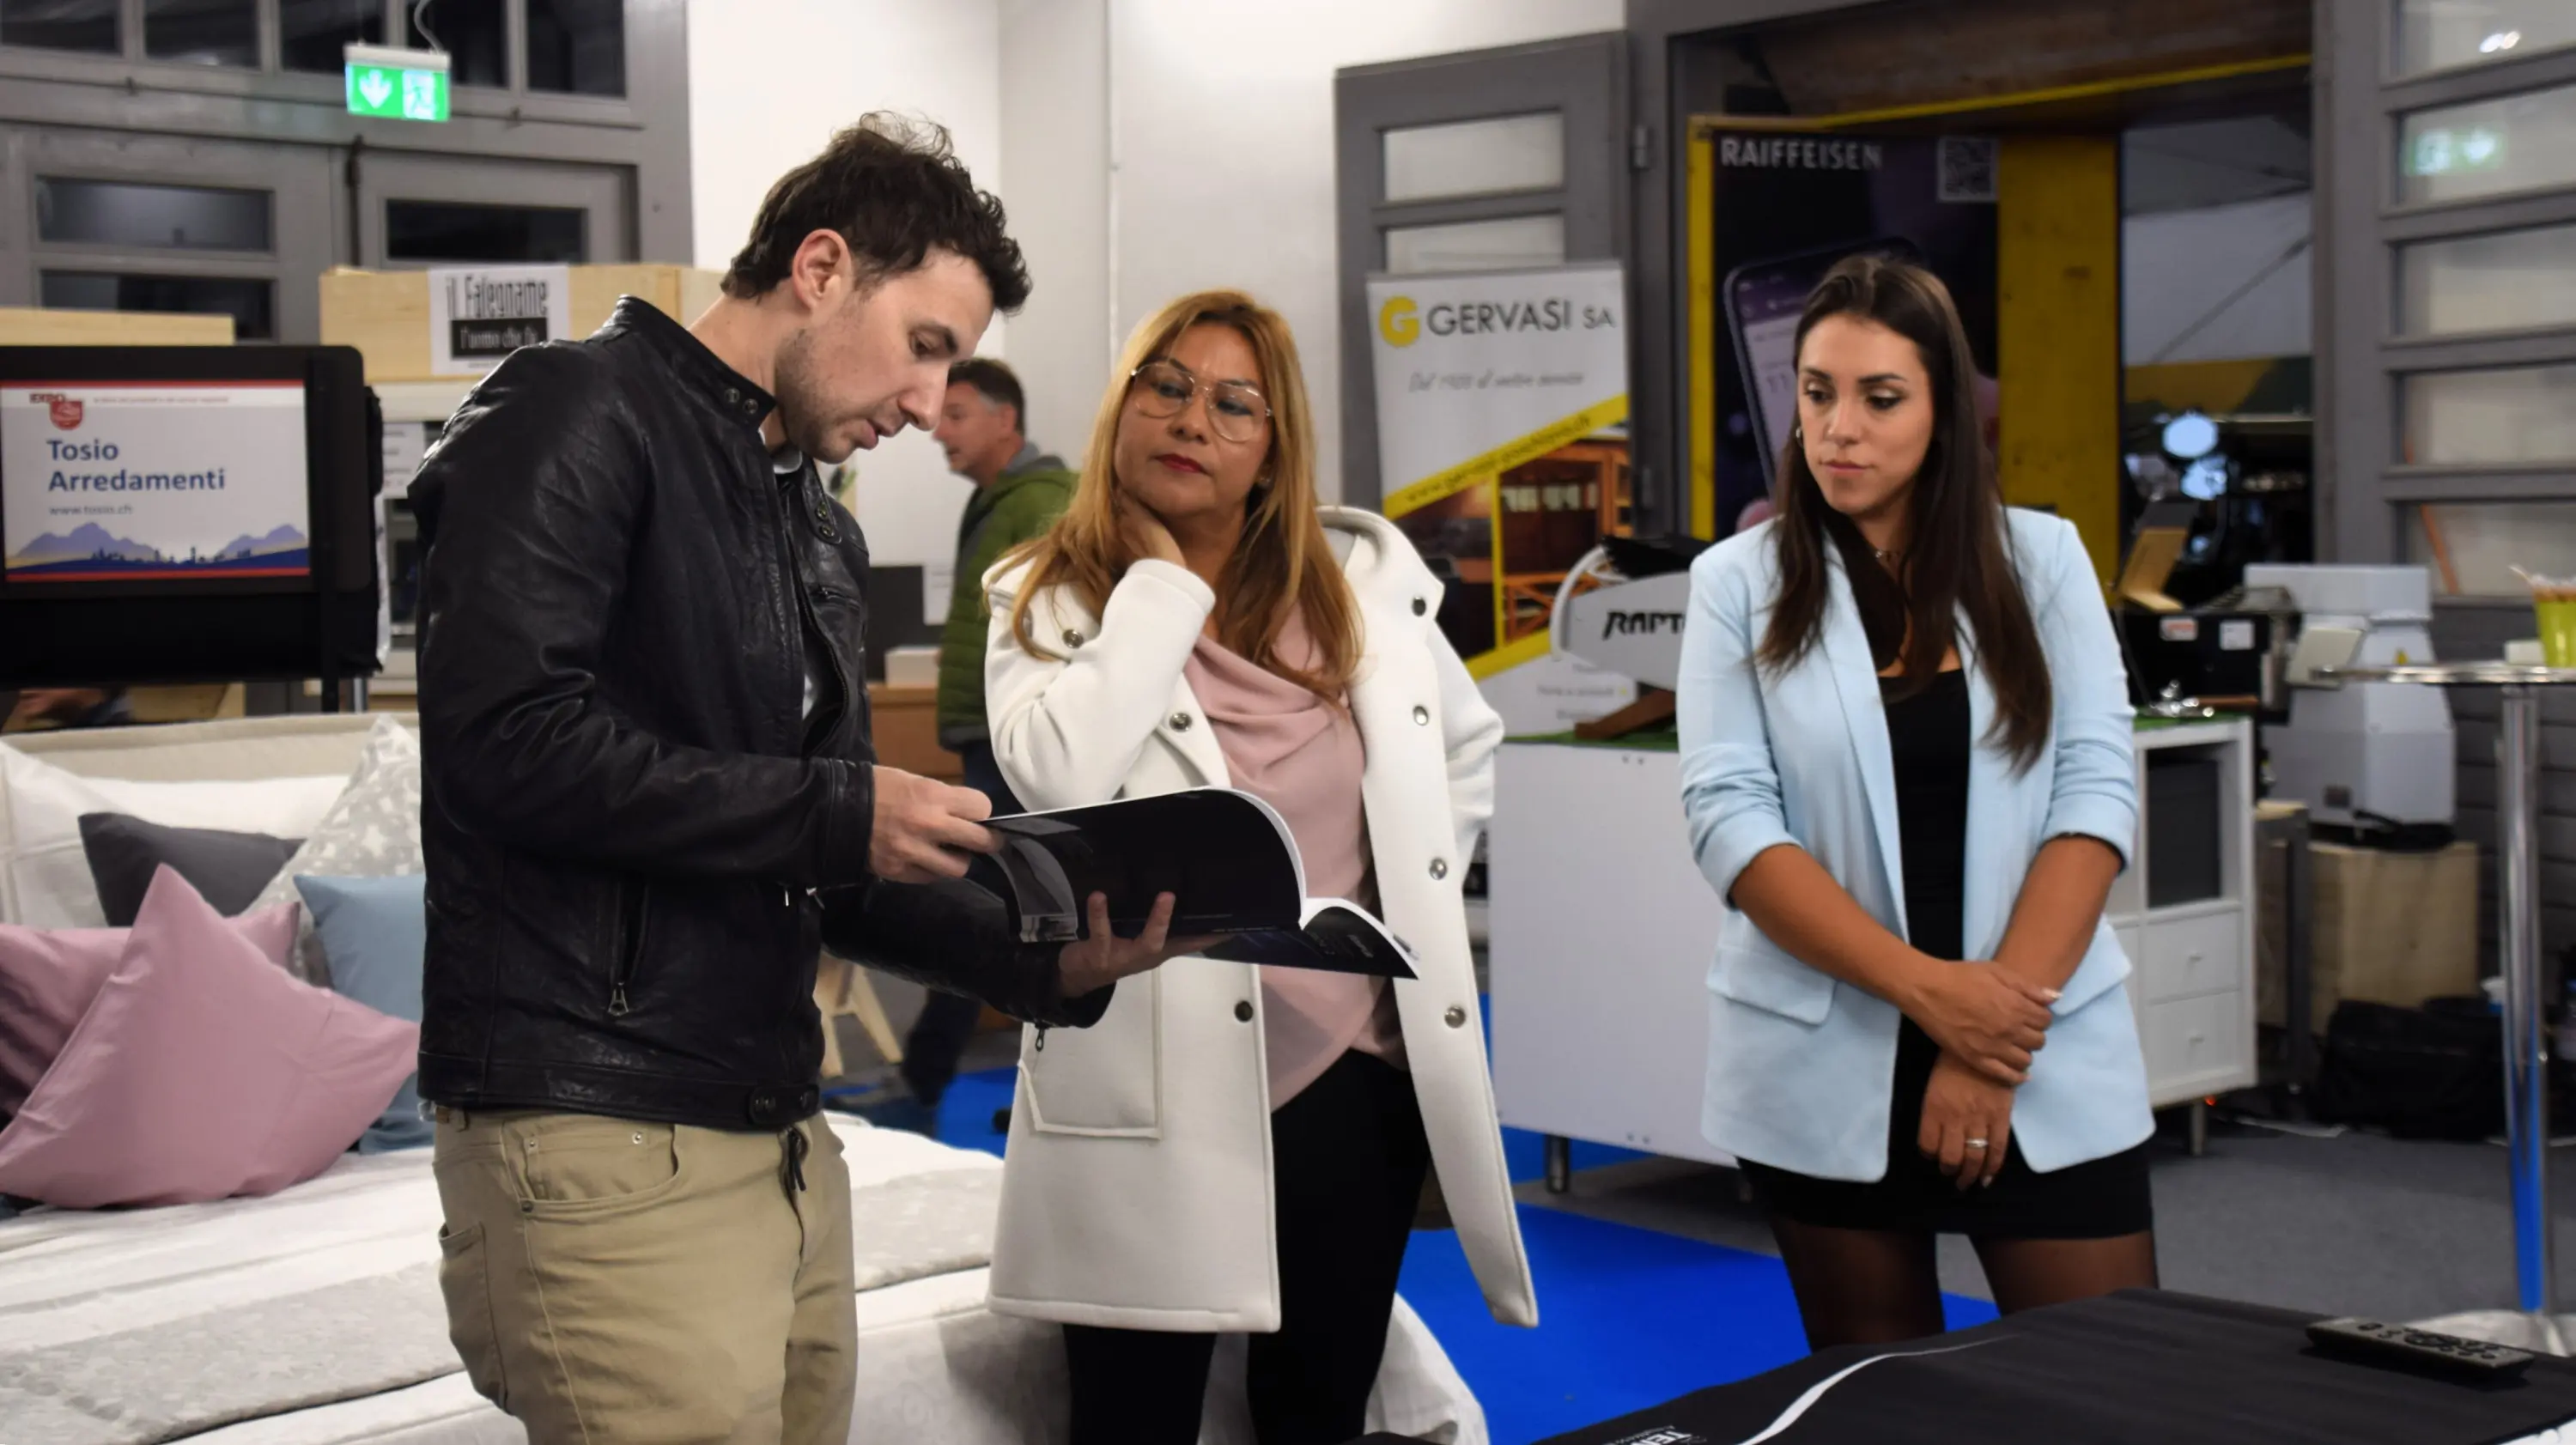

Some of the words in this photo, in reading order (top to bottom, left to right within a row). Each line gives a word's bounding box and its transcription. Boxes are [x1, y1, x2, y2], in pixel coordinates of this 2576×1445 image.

[1720, 137, 1883, 169] RAIFFEISEN
[446, 276, 457, 319] il
[465, 275, 547, 318] Falegname
[1379, 296, 1420, 348] G
[1426, 299, 1573, 336] GERVASI
[1583, 306, 1616, 330] SA
[46, 439, 118, 461] Tosio
[48, 469, 225, 492] Arredamenti
[1601, 610, 1685, 641] RAPT
